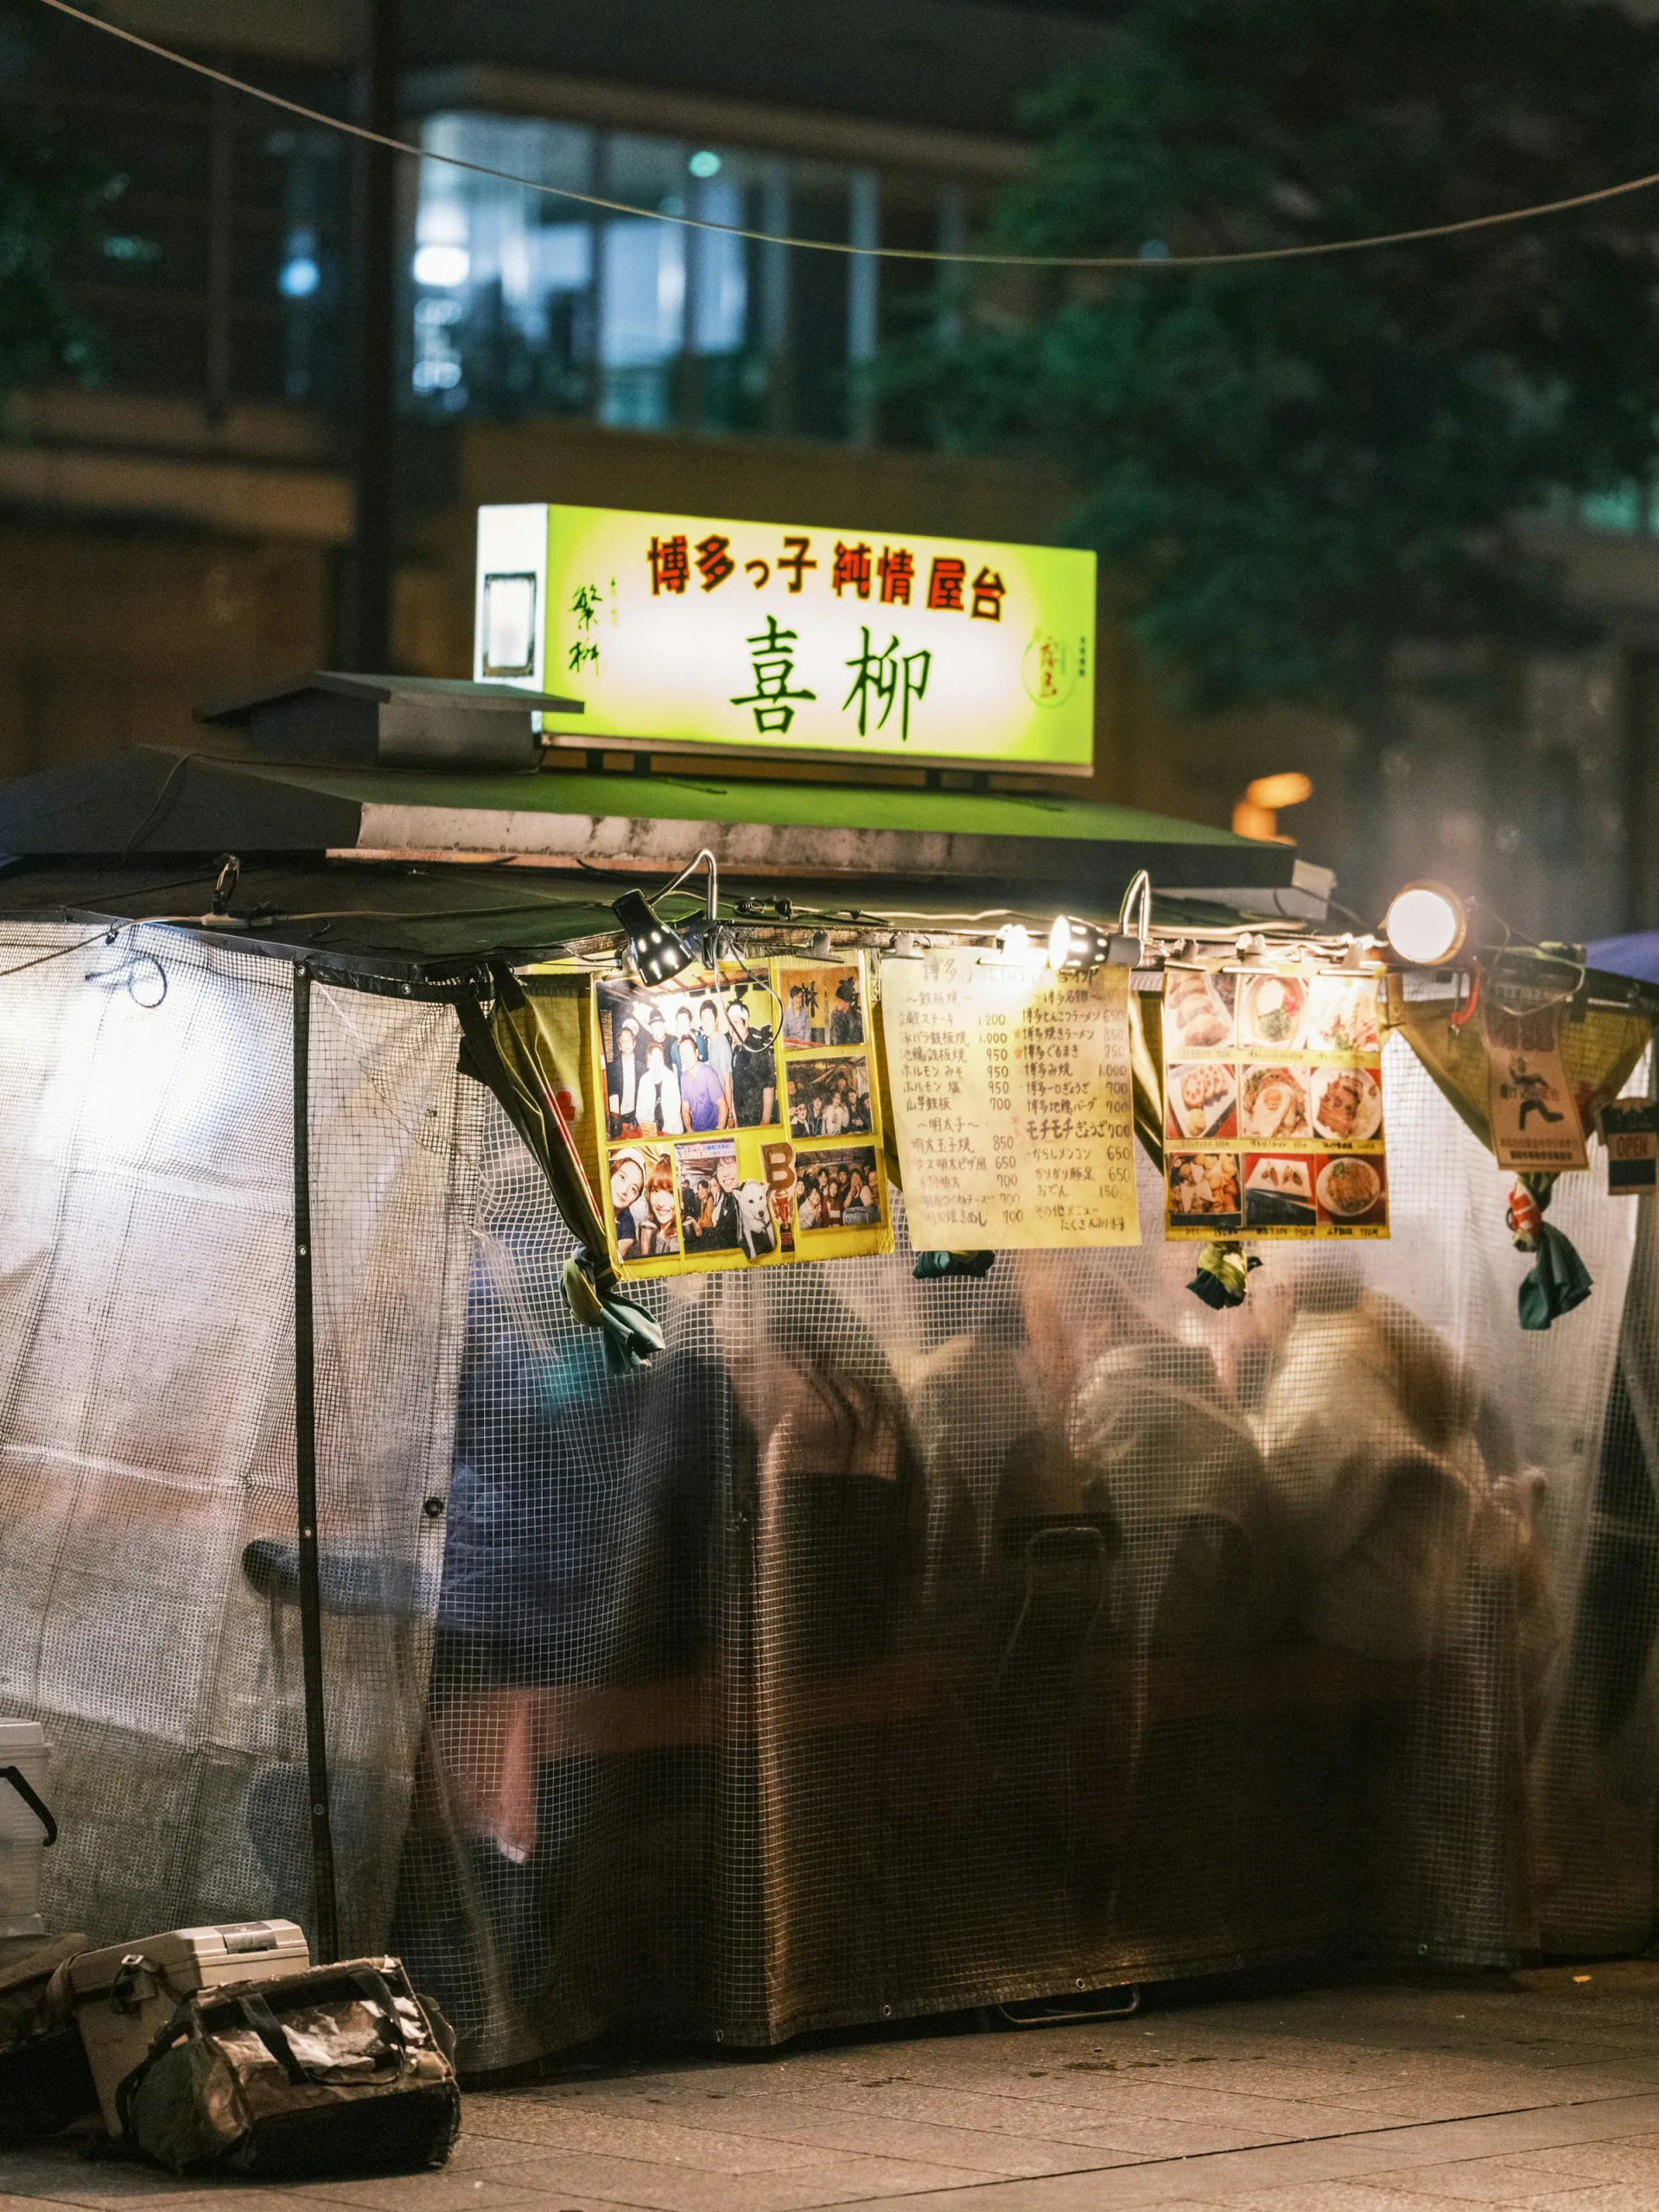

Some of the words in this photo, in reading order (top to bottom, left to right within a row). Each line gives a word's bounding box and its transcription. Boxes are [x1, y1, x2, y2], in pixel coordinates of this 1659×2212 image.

[729, 614, 931, 741] 喜柳
[986, 1048, 1007, 1061] 950
[988, 1065, 1009, 1078] 950
[988, 1081, 1009, 1095] 950
[1106, 1082, 1128, 1095] 700
[989, 1097, 1011, 1111] 700
[1106, 1101, 1128, 1114] 700
[1027, 1117, 1108, 1140] モチモチぎょうざ
[1108, 1123, 1131, 1138] 700
[993, 1135, 1014, 1151] 850
[1107, 1145, 1131, 1160] 650
[762, 1142, 794, 1191] B
[995, 1156, 1016, 1170] 650
[997, 1174, 1018, 1188] 700
[1109, 1166, 1131, 1182] 650
[1099, 1185, 1118, 1198] 150
[1000, 1193, 1020, 1206] 700
[1002, 1210, 1023, 1224] 700
